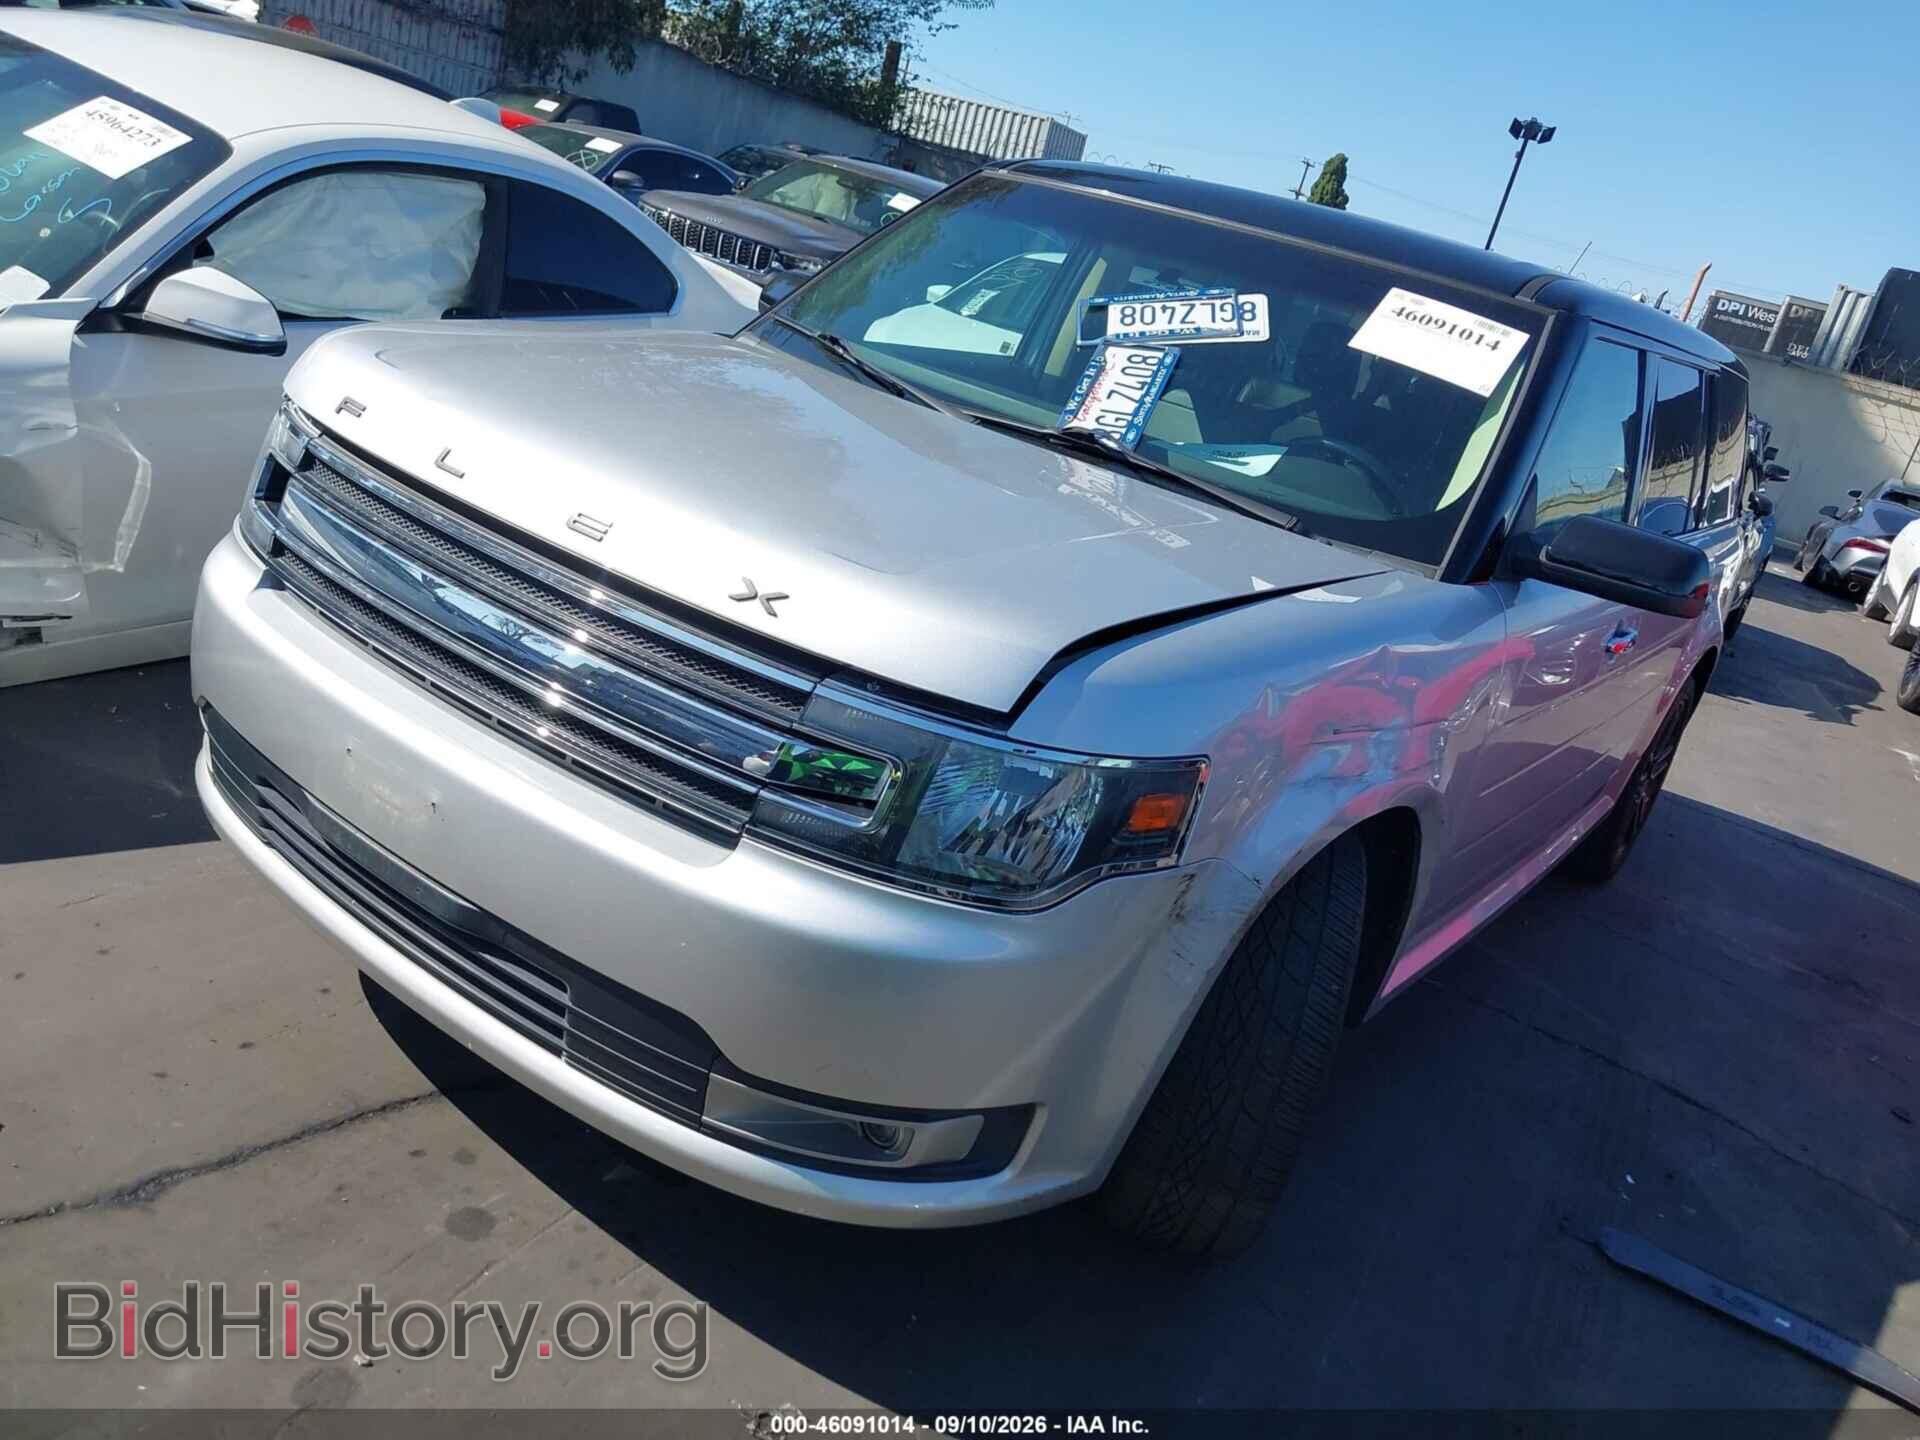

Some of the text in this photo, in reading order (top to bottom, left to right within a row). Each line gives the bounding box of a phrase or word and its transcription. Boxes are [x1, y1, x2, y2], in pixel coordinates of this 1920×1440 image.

[85, 109, 163, 147] 45964273
[1119, 301, 1257, 327] 8GLZ408
[1717, 299, 1777, 324] DPI Wes
[1391, 306, 1502, 352] 46091014
